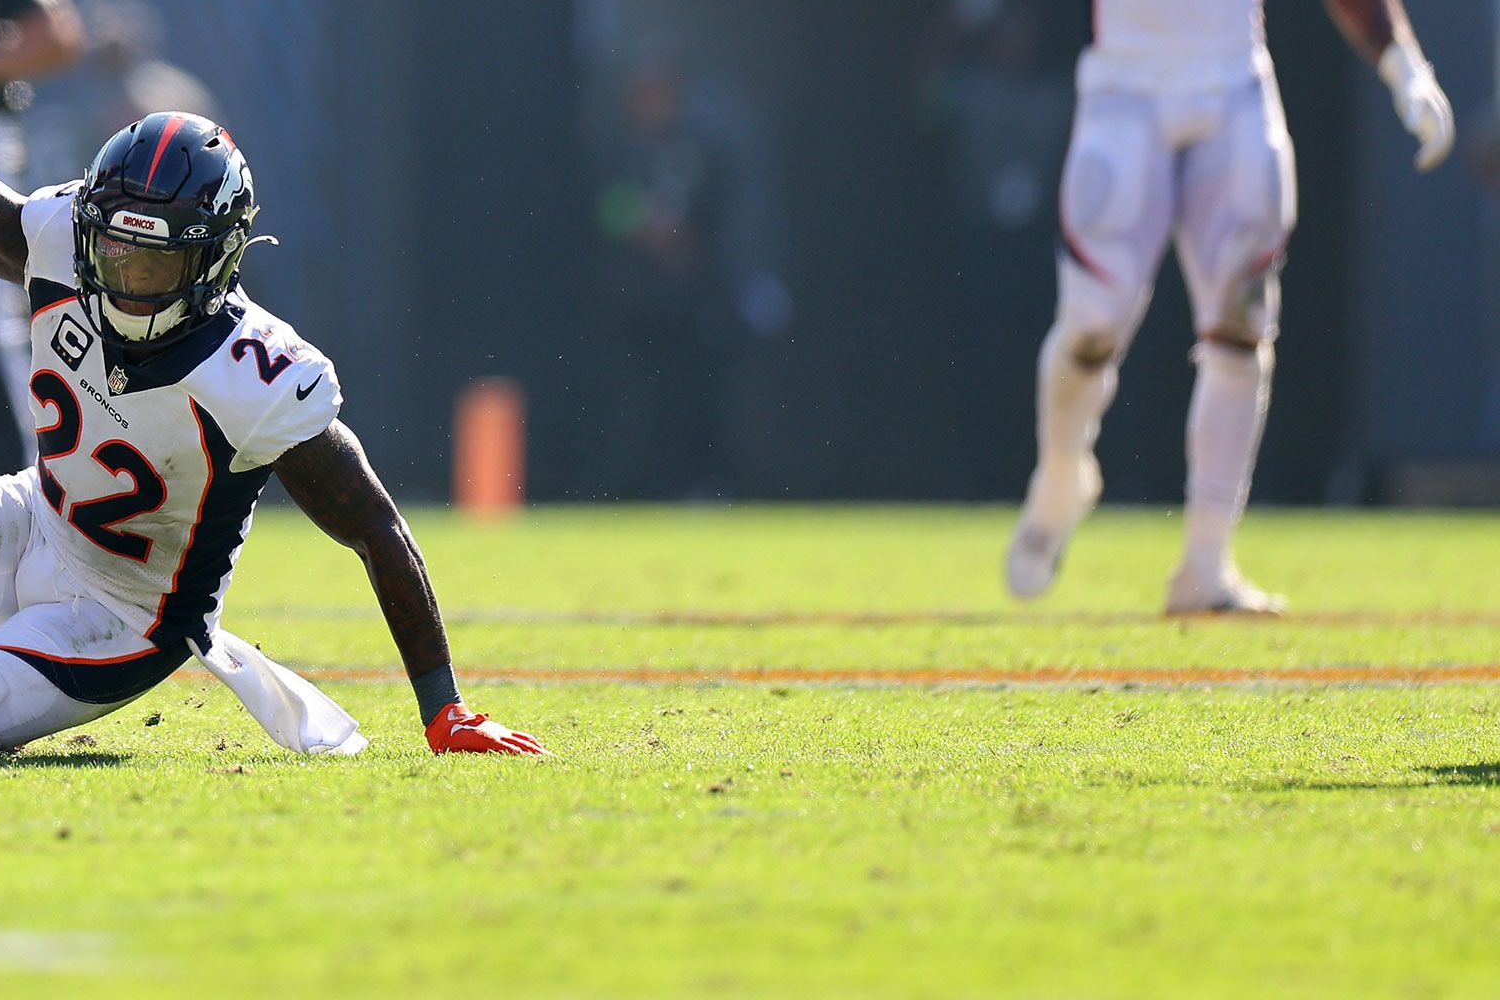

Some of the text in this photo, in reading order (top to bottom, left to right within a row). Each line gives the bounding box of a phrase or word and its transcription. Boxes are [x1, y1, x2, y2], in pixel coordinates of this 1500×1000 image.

[122, 215, 156, 231] BRONCOS
[58, 319, 88, 359] C
[79, 378, 129, 429] BRONCOS
[30, 368, 168, 564] 22
